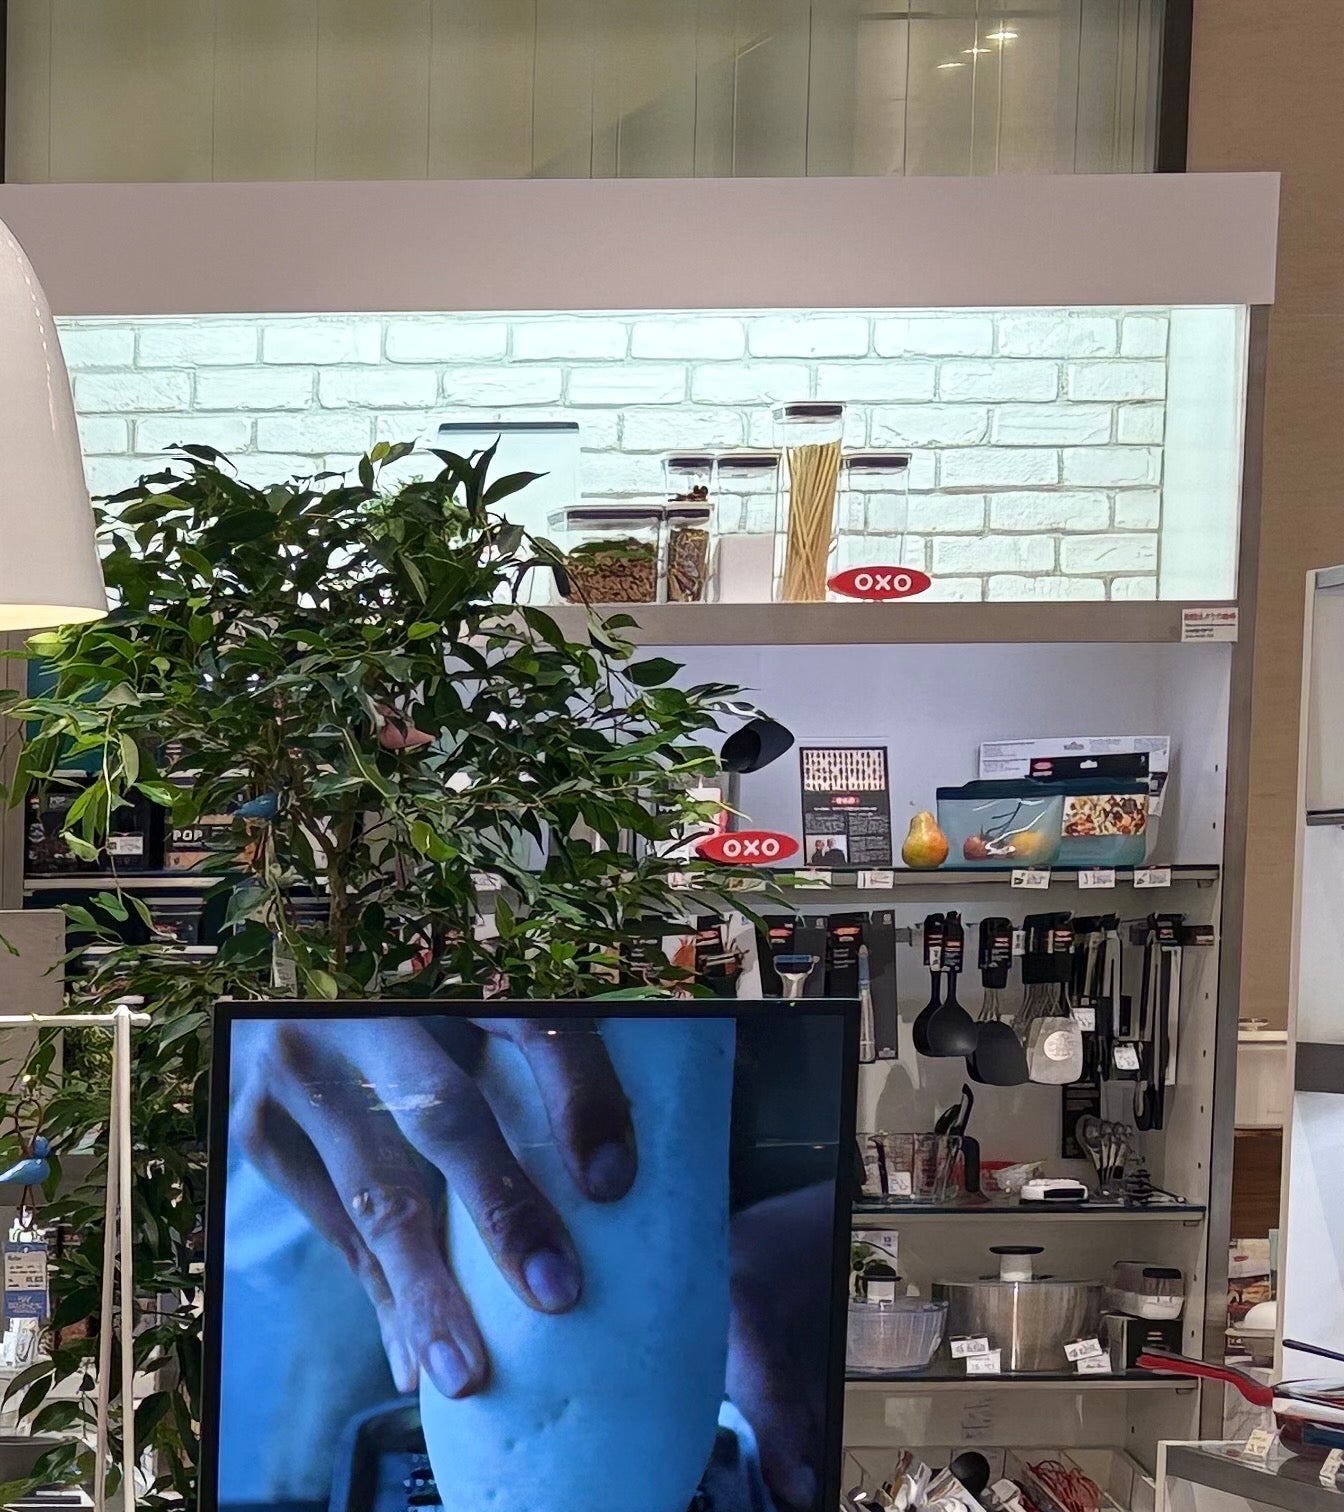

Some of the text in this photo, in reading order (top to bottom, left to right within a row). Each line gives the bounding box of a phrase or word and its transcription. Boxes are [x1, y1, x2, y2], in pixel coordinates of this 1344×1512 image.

[854, 573, 912, 592] OXO
[172, 829, 203, 841] POP
[723, 838, 780, 857] OXO
